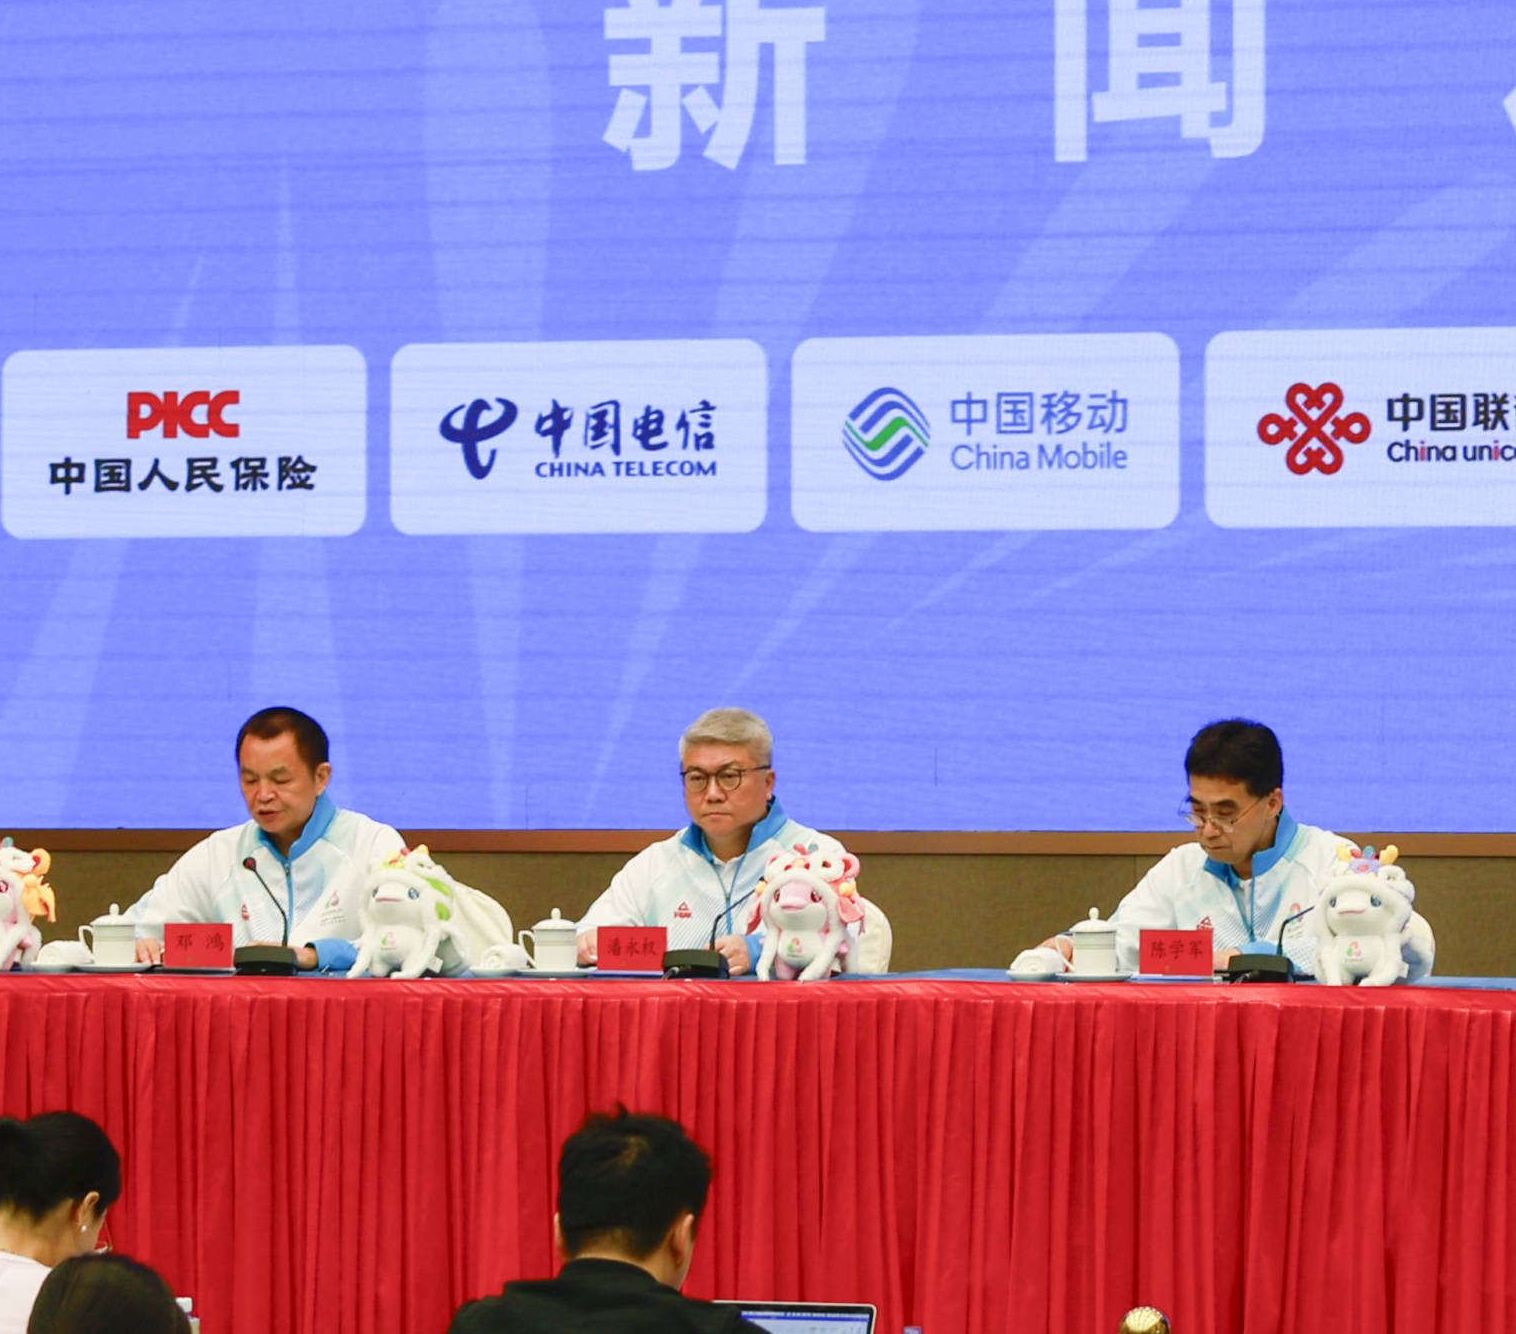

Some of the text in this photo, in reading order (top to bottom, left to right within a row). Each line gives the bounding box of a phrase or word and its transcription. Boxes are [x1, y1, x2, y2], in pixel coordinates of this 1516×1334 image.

[127, 390, 240, 439] PICC
[534, 399, 717, 458] 中国电信
[950, 389, 1129, 436] 中国移动
[534, 460, 717, 478] CHINA TELECOM
[950, 441, 1128, 471] China Mobile
[1386, 439, 1457, 463] China
[48, 455, 317, 496] 中国人民保险
